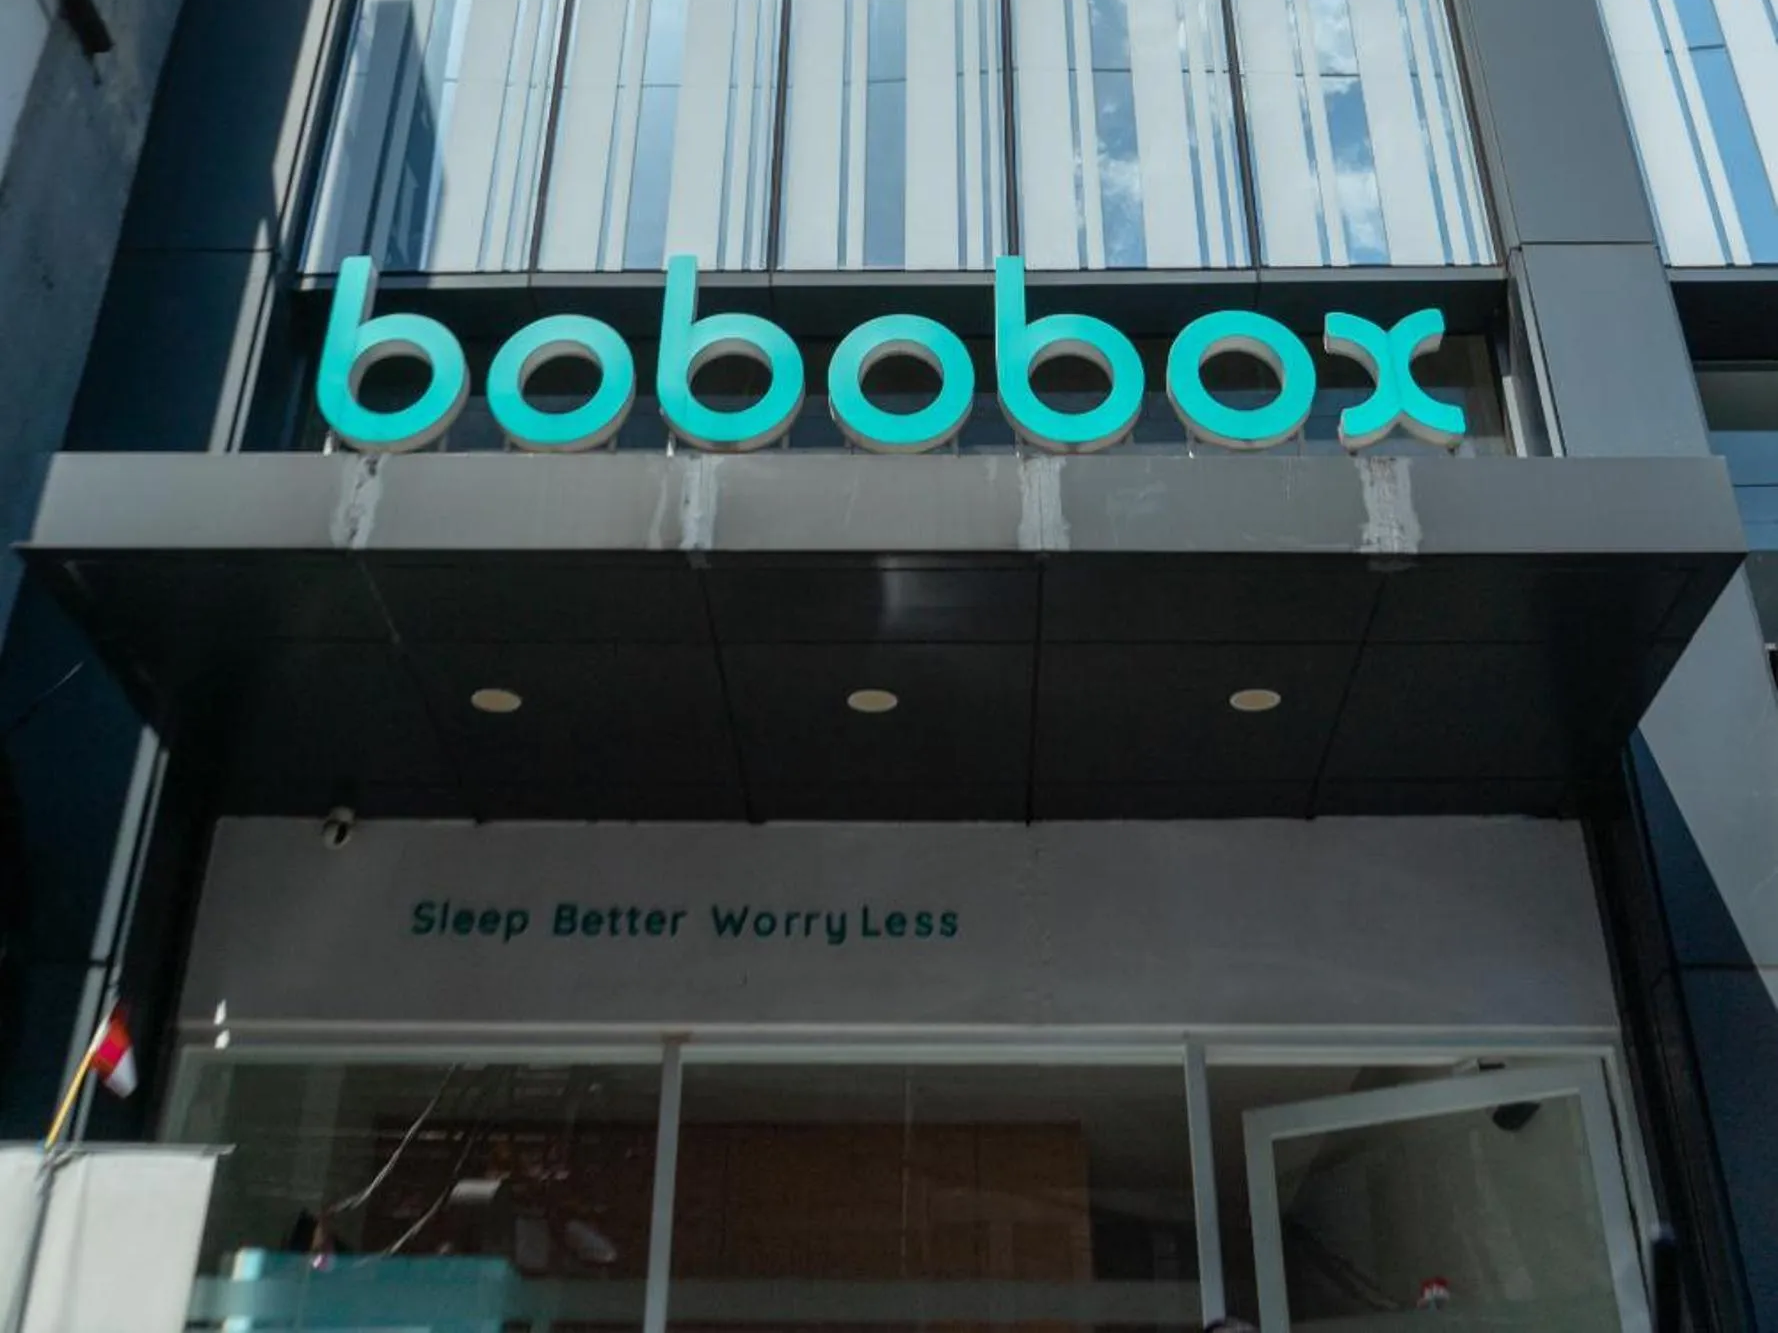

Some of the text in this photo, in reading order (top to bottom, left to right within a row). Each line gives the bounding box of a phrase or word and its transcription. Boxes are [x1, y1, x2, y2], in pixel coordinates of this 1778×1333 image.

[316, 254, 1468, 450] bobobox
[411, 899, 961, 945] Sleep Better Worry Less
